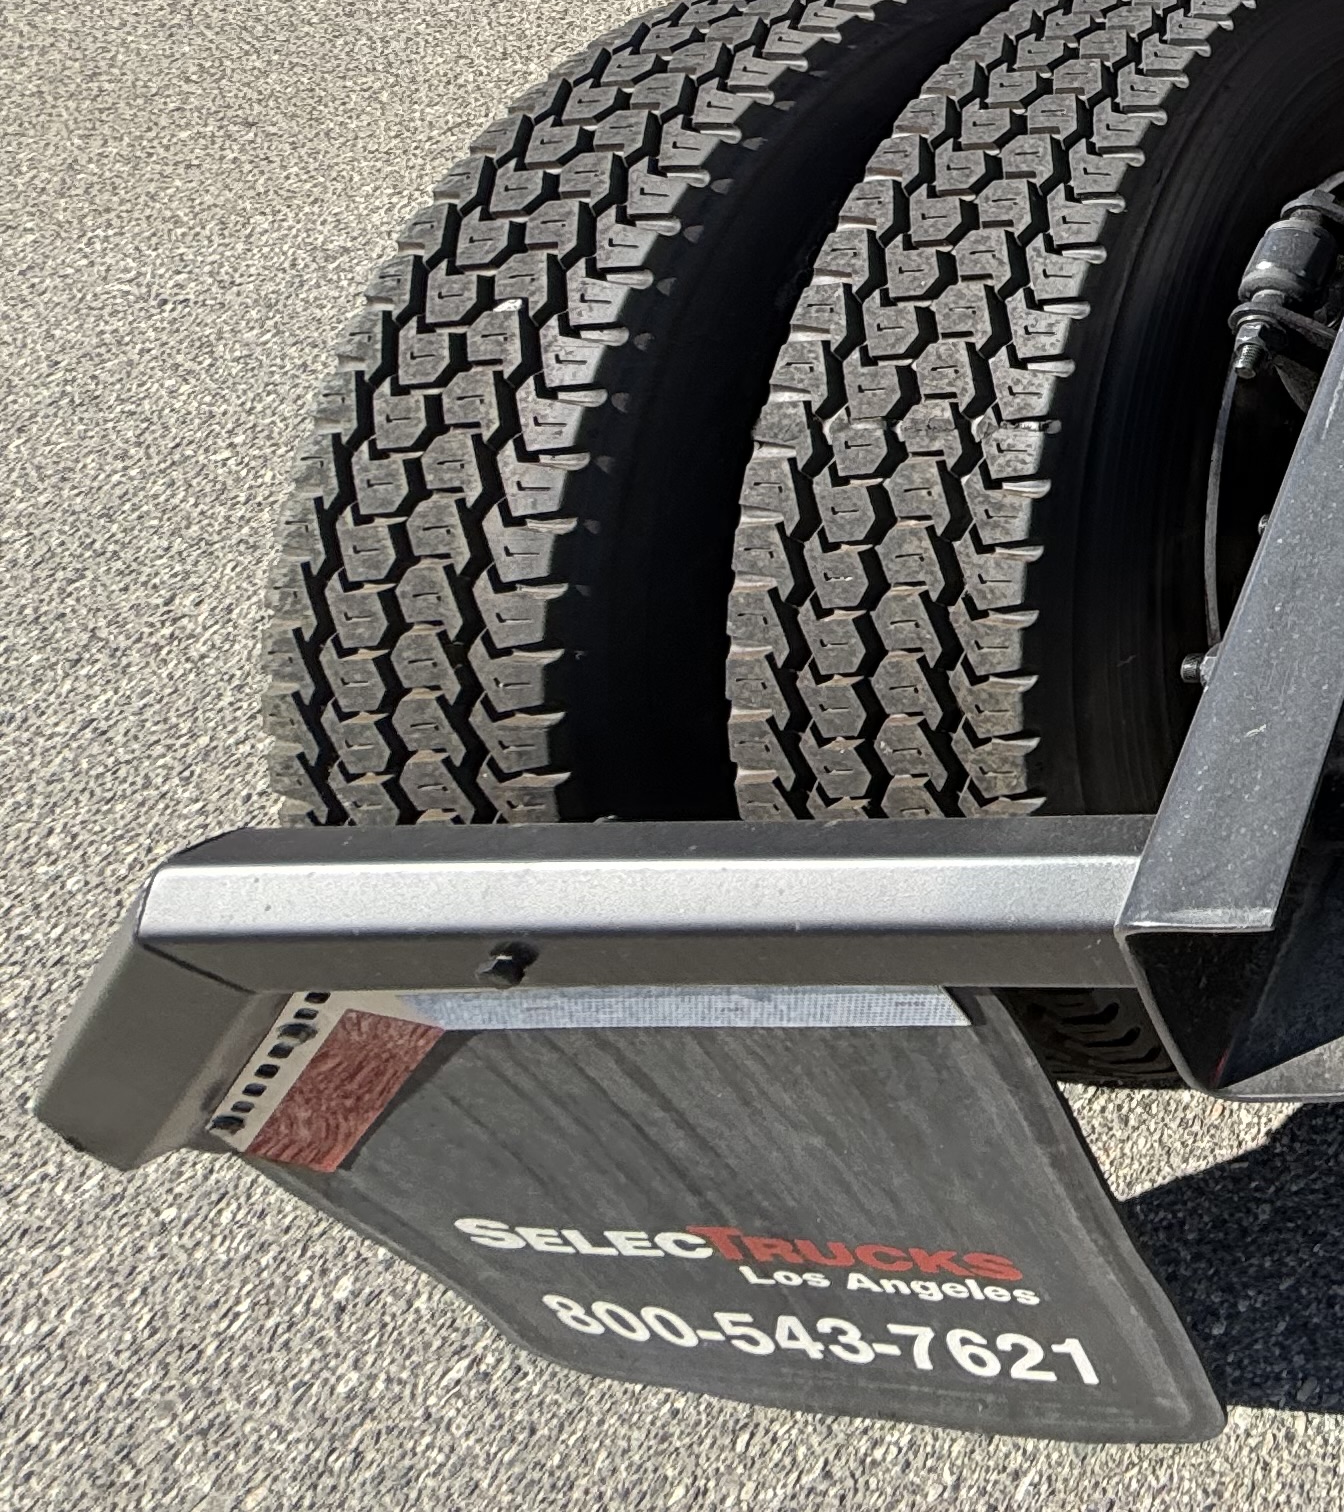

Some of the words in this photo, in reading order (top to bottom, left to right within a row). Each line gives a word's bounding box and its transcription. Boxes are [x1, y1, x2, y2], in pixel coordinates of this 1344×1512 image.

[738, 1265, 831, 1288] Los
[846, 1273, 1041, 1306] Angeles
[541, 1293, 1100, 1385] 800-543-7621
